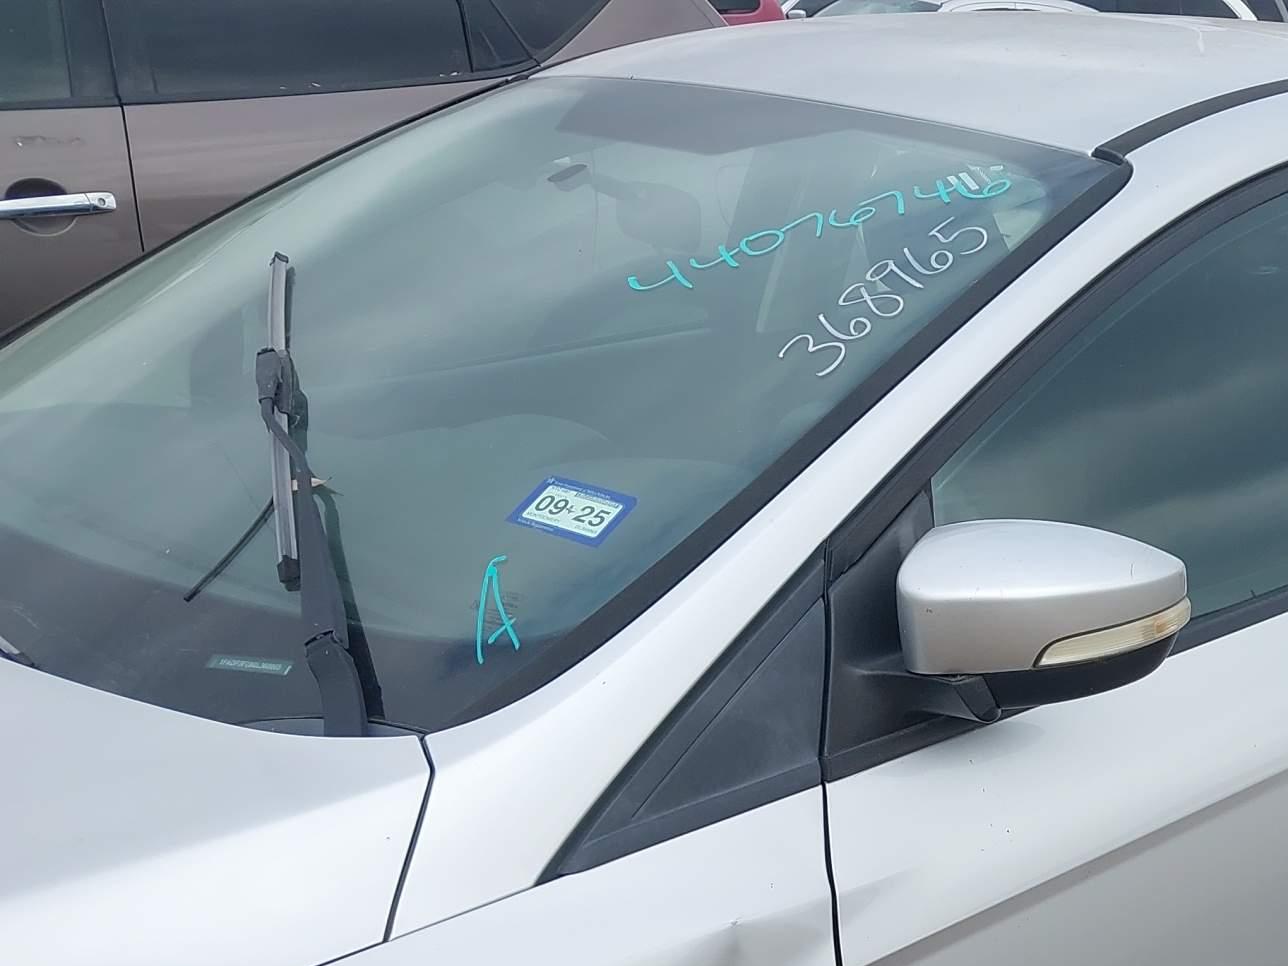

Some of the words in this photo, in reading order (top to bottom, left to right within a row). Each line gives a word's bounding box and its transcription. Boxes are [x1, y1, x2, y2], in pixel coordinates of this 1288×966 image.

[778, 216, 988, 377] 368965
[534, 494, 568, 515] 09
[571, 505, 612, 527] 25
